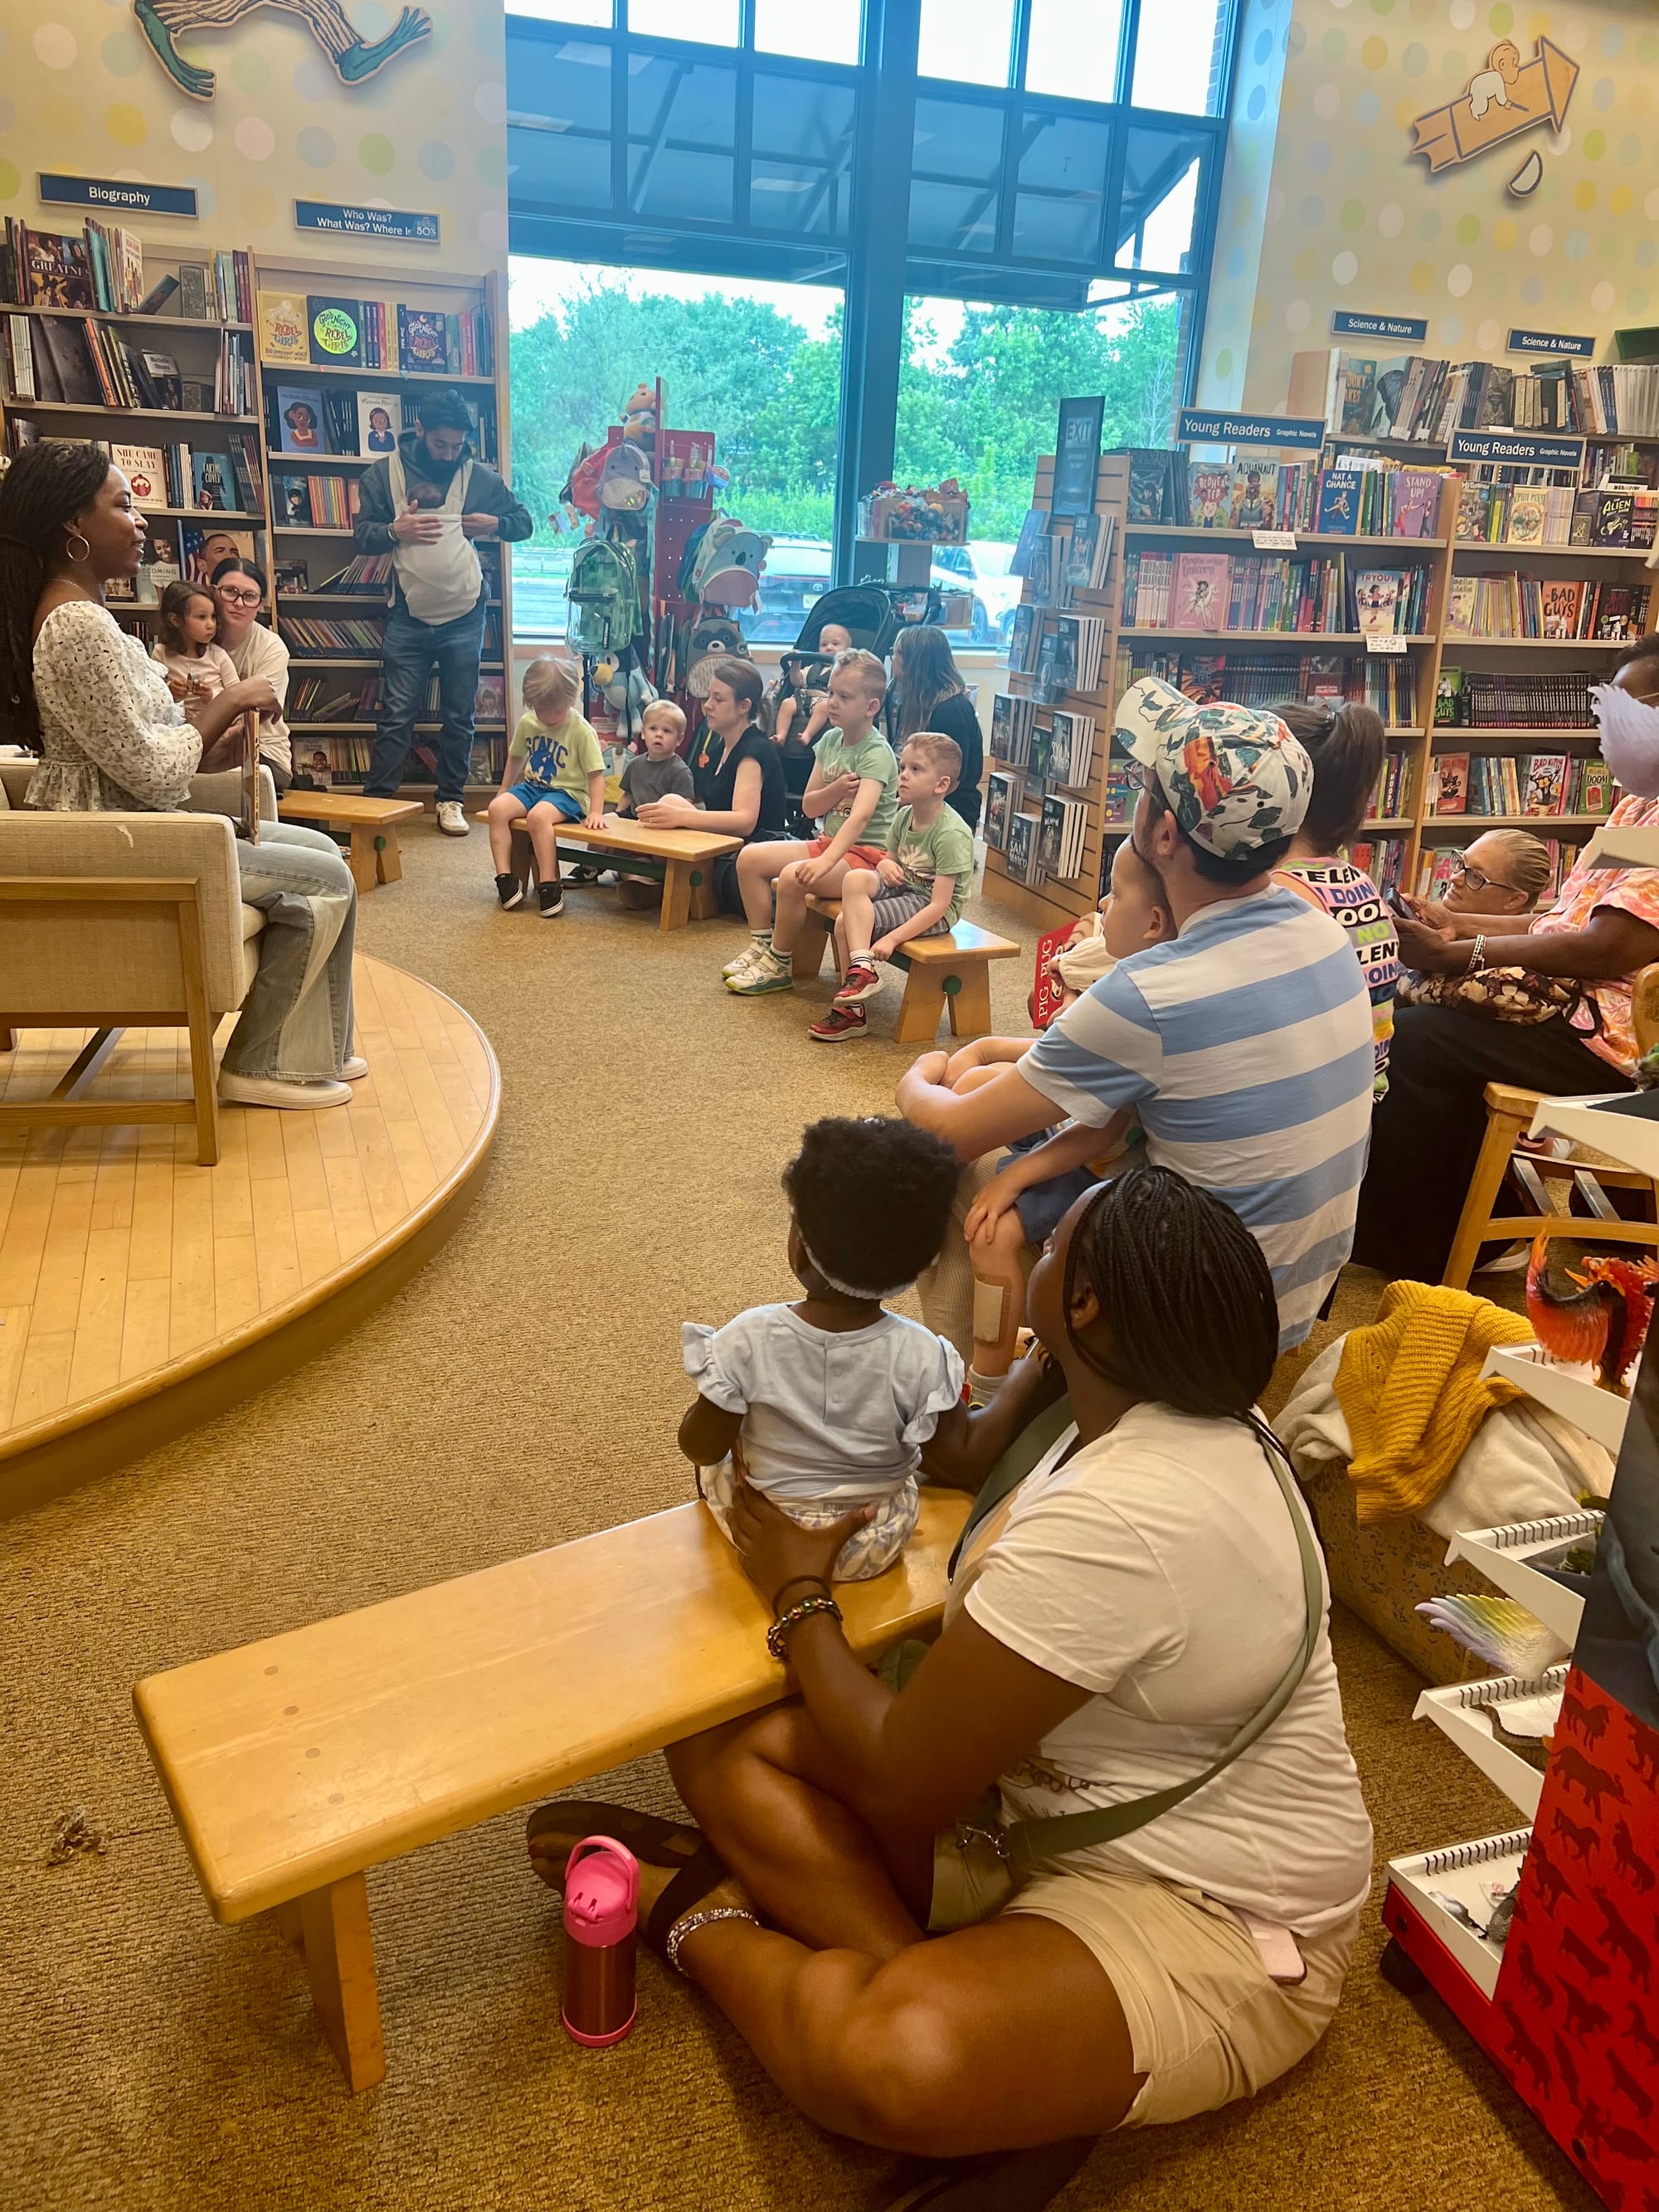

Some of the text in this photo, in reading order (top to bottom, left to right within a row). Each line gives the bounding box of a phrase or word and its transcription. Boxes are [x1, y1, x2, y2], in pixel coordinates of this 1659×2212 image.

[89, 186, 150, 206] Biography
[343, 208, 392, 222] Who Was?
[317, 216, 342, 229] What
[344, 221, 370, 232] Was?
[373, 223, 402, 235] Where
[416, 226, 436, 236] 50%
[319, 311, 333, 328] GOOD
[333, 314, 352, 331] NIGHT
[1348, 318, 1413, 333] Science & Nature
[275, 322, 302, 336] REBEL
[325, 327, 353, 341] REBEL
[321, 338, 349, 352] GIRLS
[1521, 336, 1582, 351] Science & Nature
[1067, 420, 1094, 441] EXIT
[1185, 418, 1220, 437] Young
[1223, 421, 1271, 437] Readers
[1276, 429, 1297, 437] Graphic
[117, 448, 158, 460] SHE CAME
[1458, 439, 1491, 455] Young
[1492, 441, 1535, 456] Readers
[1539, 447, 1559, 456] Graphic
[121, 458, 156, 469] TO SLAY
[1237, 463, 1277, 475] AQUANAUT
[1326, 479, 1356, 489] CHANCE
[1406, 476, 1432, 489] STAND
[1207, 489, 1221, 499] TED
[1410, 488, 1424, 498] UP!
[1603, 498, 1632, 515] ALIEN
[1361, 573, 1394, 581] TRYOUT
[1551, 587, 1575, 603] BAD
[1544, 601, 1574, 617] GUYS
[1438, 698, 1454, 707] BAD
[1436, 707, 1454, 717] GUYS
[1534, 758, 1563, 770] BAD KITTY
[1587, 775, 1608, 784] DOOM
[1386, 773, 1395, 809] HOOPS
[1010, 840, 1024, 858] SAN
[1292, 865, 1360, 884] ELEN
[1356, 921, 1389, 944] NO
[1356, 941, 1399, 965] LEN
[1039, 939, 1053, 1018] PIG PUG
[1364, 963, 1397, 984] OIN
